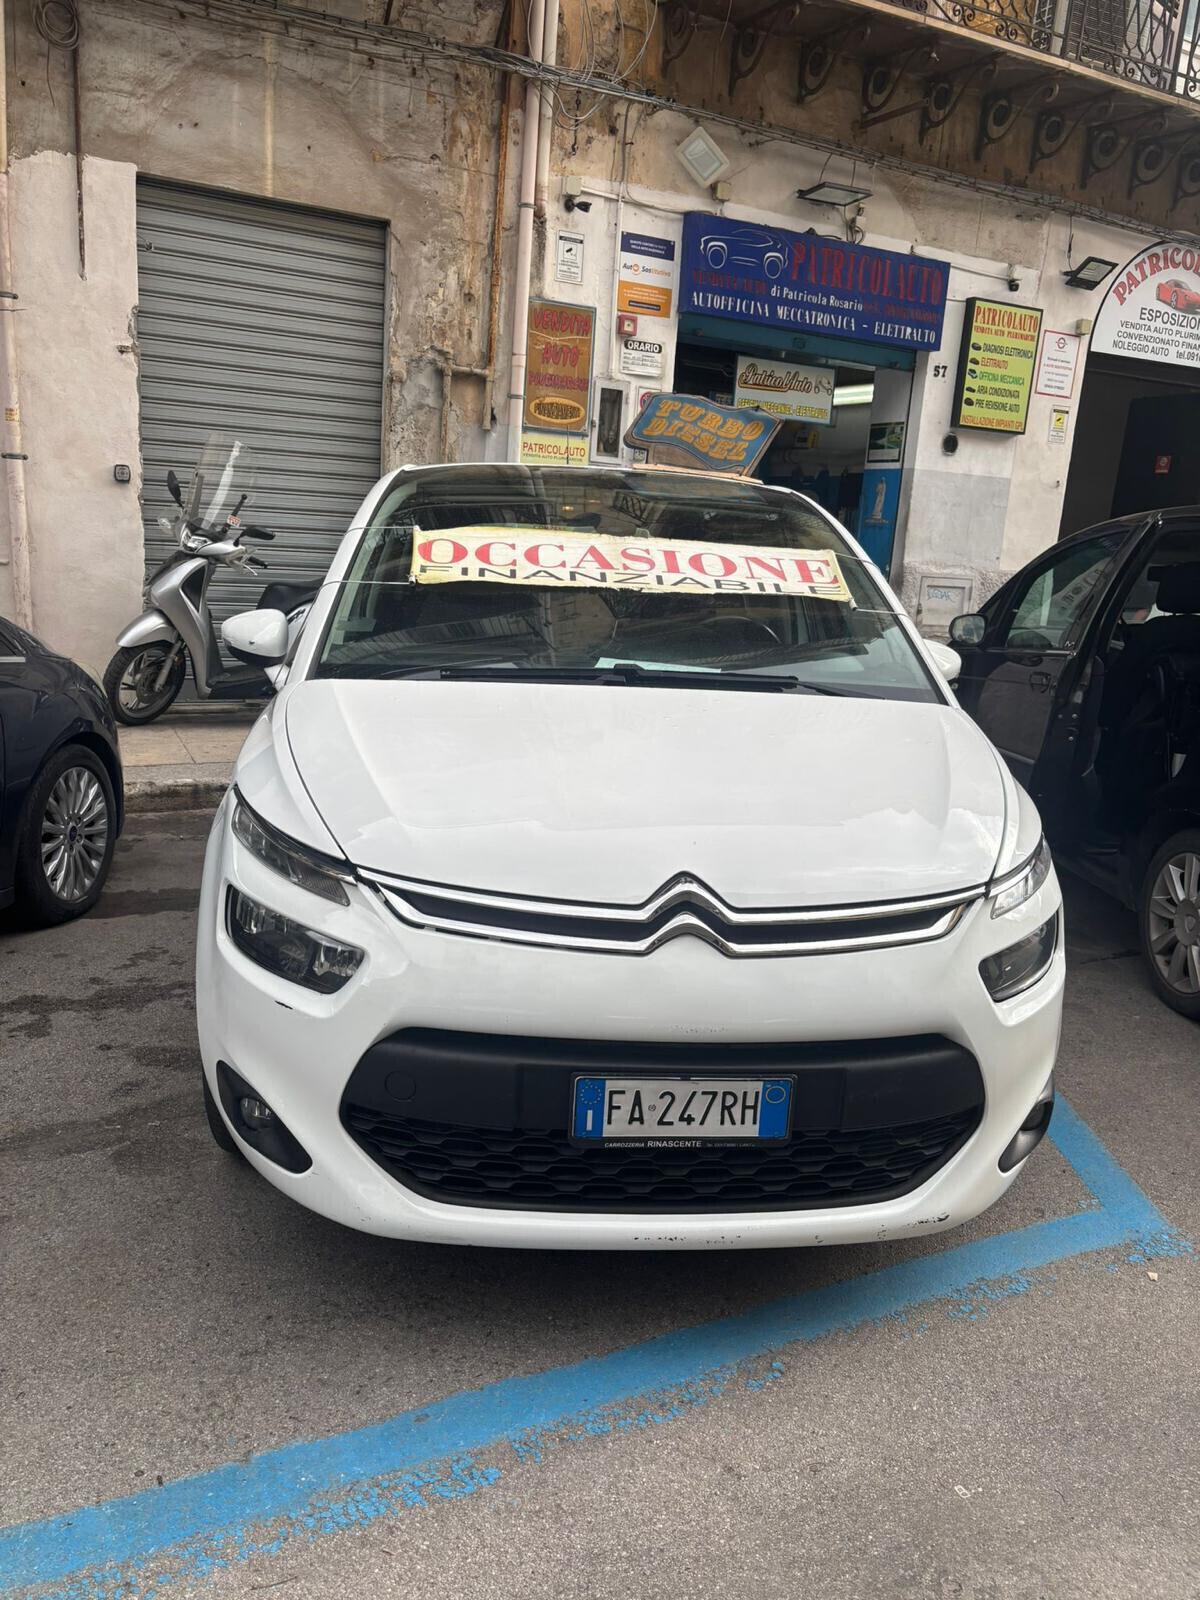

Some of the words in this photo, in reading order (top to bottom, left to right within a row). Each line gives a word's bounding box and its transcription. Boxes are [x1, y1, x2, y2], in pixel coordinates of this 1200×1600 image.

[791, 239, 943, 305] PATRICOLAUTO
[770, 285, 780, 297] di
[783, 287, 827, 305] Patricola
[829, 295, 863, 312] Rosario
[533, 307, 592, 337] VENDITA
[692, 291, 769, 317] AUTOFFICINA
[777, 304, 855, 332] MECCATRONICA
[874, 321, 935, 344] ELETTRAUTO
[975, 305, 1039, 333] PATRICOLAUTO
[1120, 320, 1151, 333] VENDITA
[1153, 326, 1174, 337] AUTO
[627, 341, 660, 353] ORARIO
[1117, 330, 1181, 348] CONVENZIONATO
[541, 342, 580, 368] AUTO
[982, 342, 1004, 355] DIAGNOSI
[1005, 346, 1034, 360] ELETTRONICA
[1112, 340, 1150, 354] NOLEGGIO
[1151, 346, 1170, 357] AUTO
[1176, 350, 1200, 363] tel.091
[933, 365, 948, 378] 57
[980, 357, 1009, 370] ELETTRAUTO
[979, 371, 999, 382] OFFICINA
[1000, 374, 1025, 386] MECCANICA
[976, 385, 987, 395] ARIA
[989, 387, 1020, 399] CONDIZIONATA
[975, 399, 985, 408] PRE
[1009, 403, 1020, 413] AUTO
[655, 399, 765, 441] TURBO
[522, 441, 586, 458] PATRICOLAUTO
[642, 417, 750, 462] DIESEL
[417, 538, 839, 585] OCCASIONE
[420, 565, 848, 595] FINANZIABILE
[647, 1140, 702, 1148] RINASCENTE
